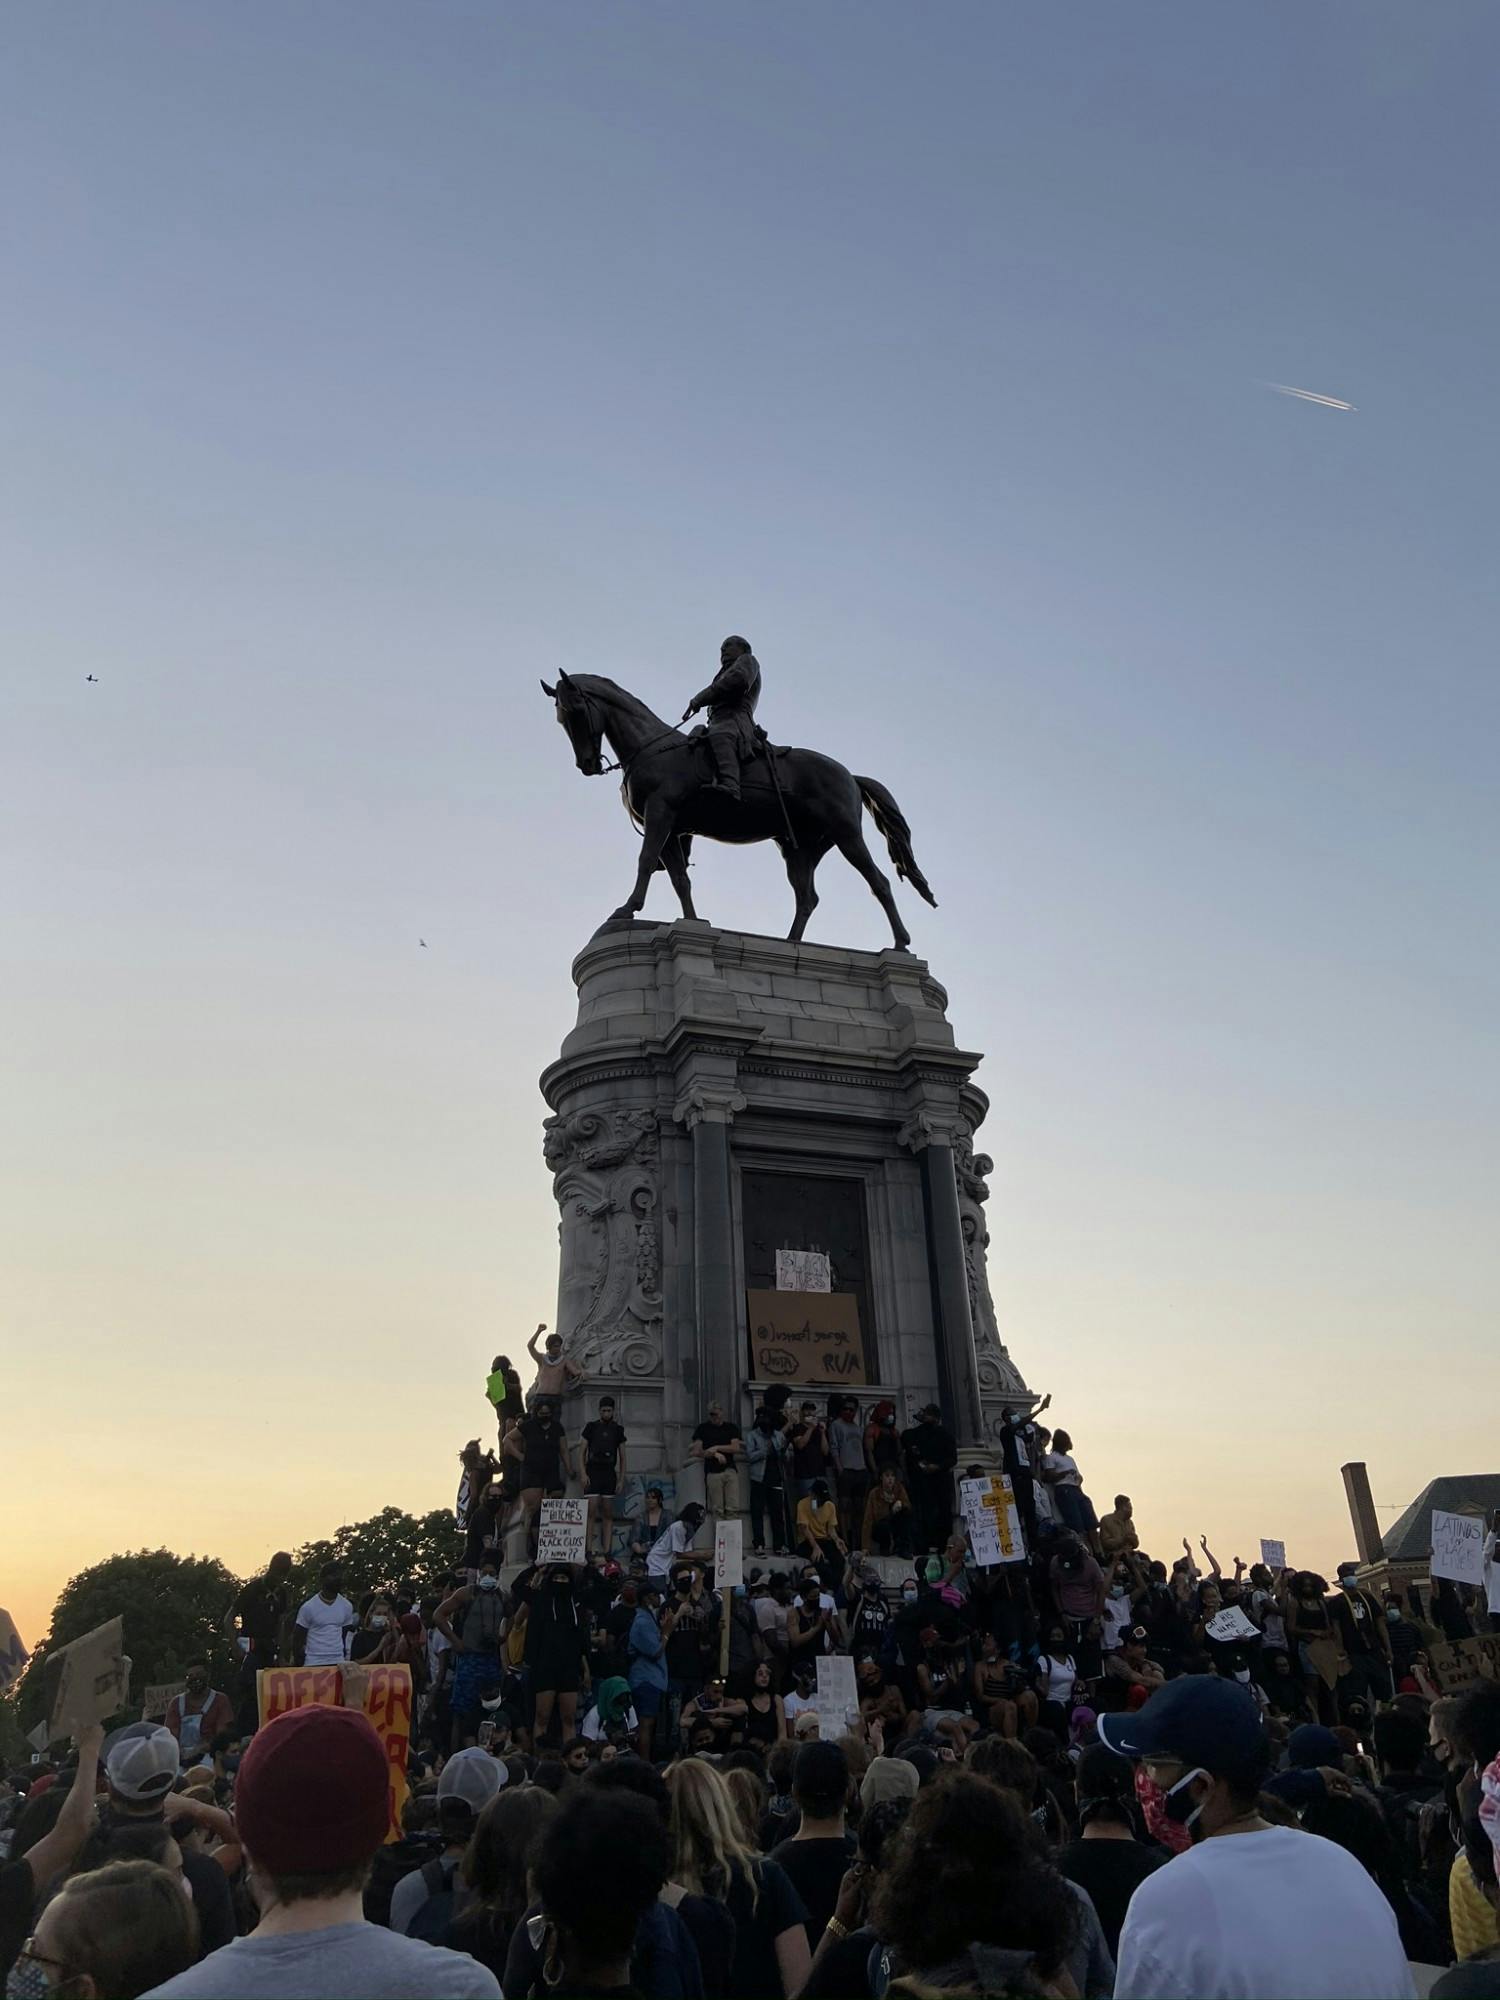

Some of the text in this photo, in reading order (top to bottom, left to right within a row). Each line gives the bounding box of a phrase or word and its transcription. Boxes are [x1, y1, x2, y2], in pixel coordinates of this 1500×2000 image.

[781, 1251, 829, 1277] BLACK
[780, 1267, 825, 1289] LIVES
[822, 1352, 860, 1374] RVA
[962, 1482, 973, 1493] I
[543, 1500, 579, 1509] WHERE ARE
[550, 1509, 582, 1521] BITCHES
[1434, 1514, 1481, 1539] LATINOS
[539, 1536, 562, 1547] BLACK
